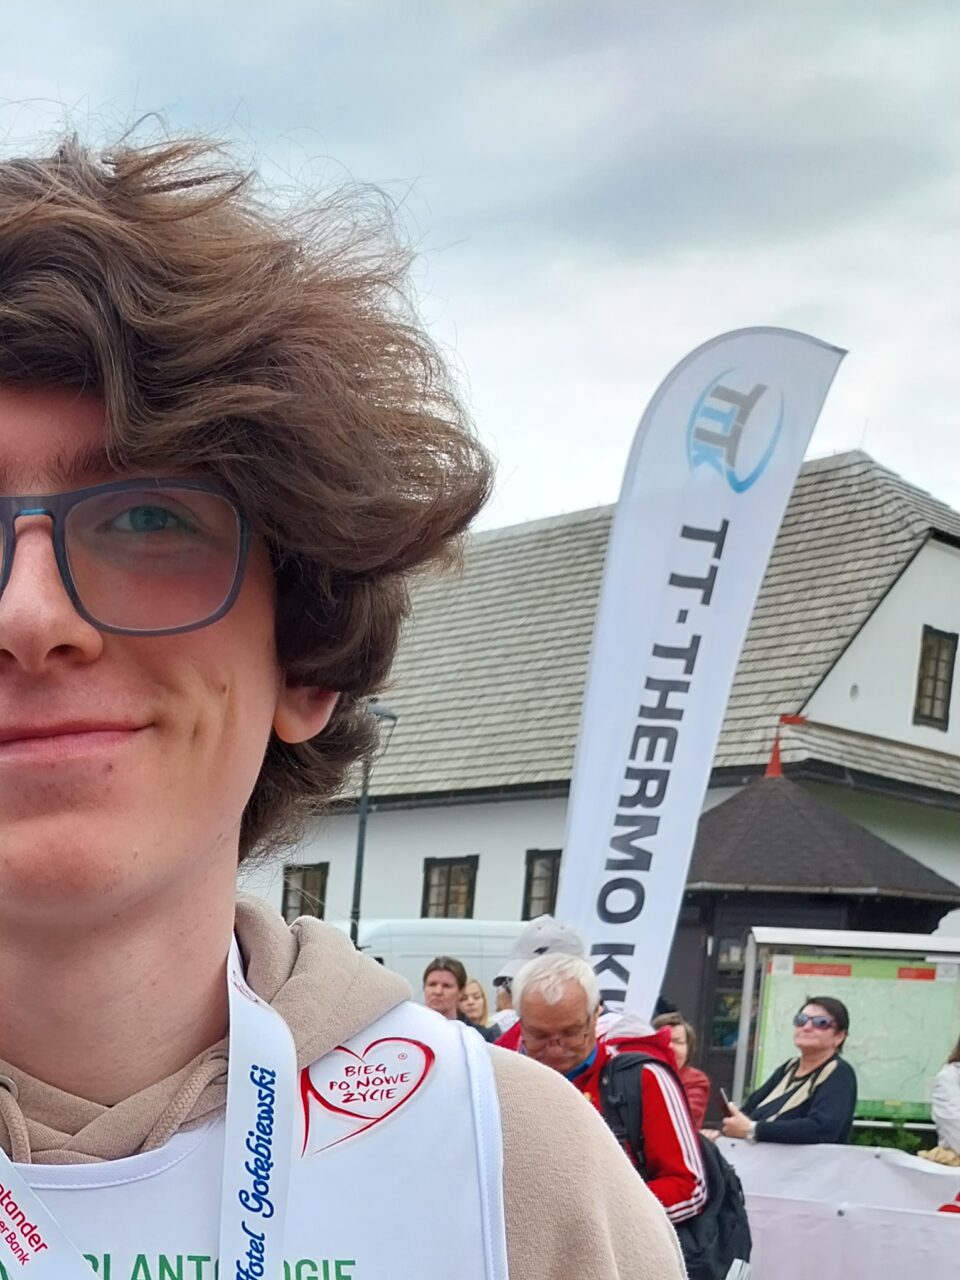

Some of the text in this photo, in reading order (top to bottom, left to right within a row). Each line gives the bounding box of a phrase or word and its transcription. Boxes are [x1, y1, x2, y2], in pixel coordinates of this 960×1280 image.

[590, 518, 730, 1012] TT-THERMO KI
[344, 1063, 387, 1077] BIEG
[329, 1072, 411, 1091] PO NOWE
[342, 1088, 397, 1103] ŻYCIE
[5, 1231, 29, 1266] Bank
